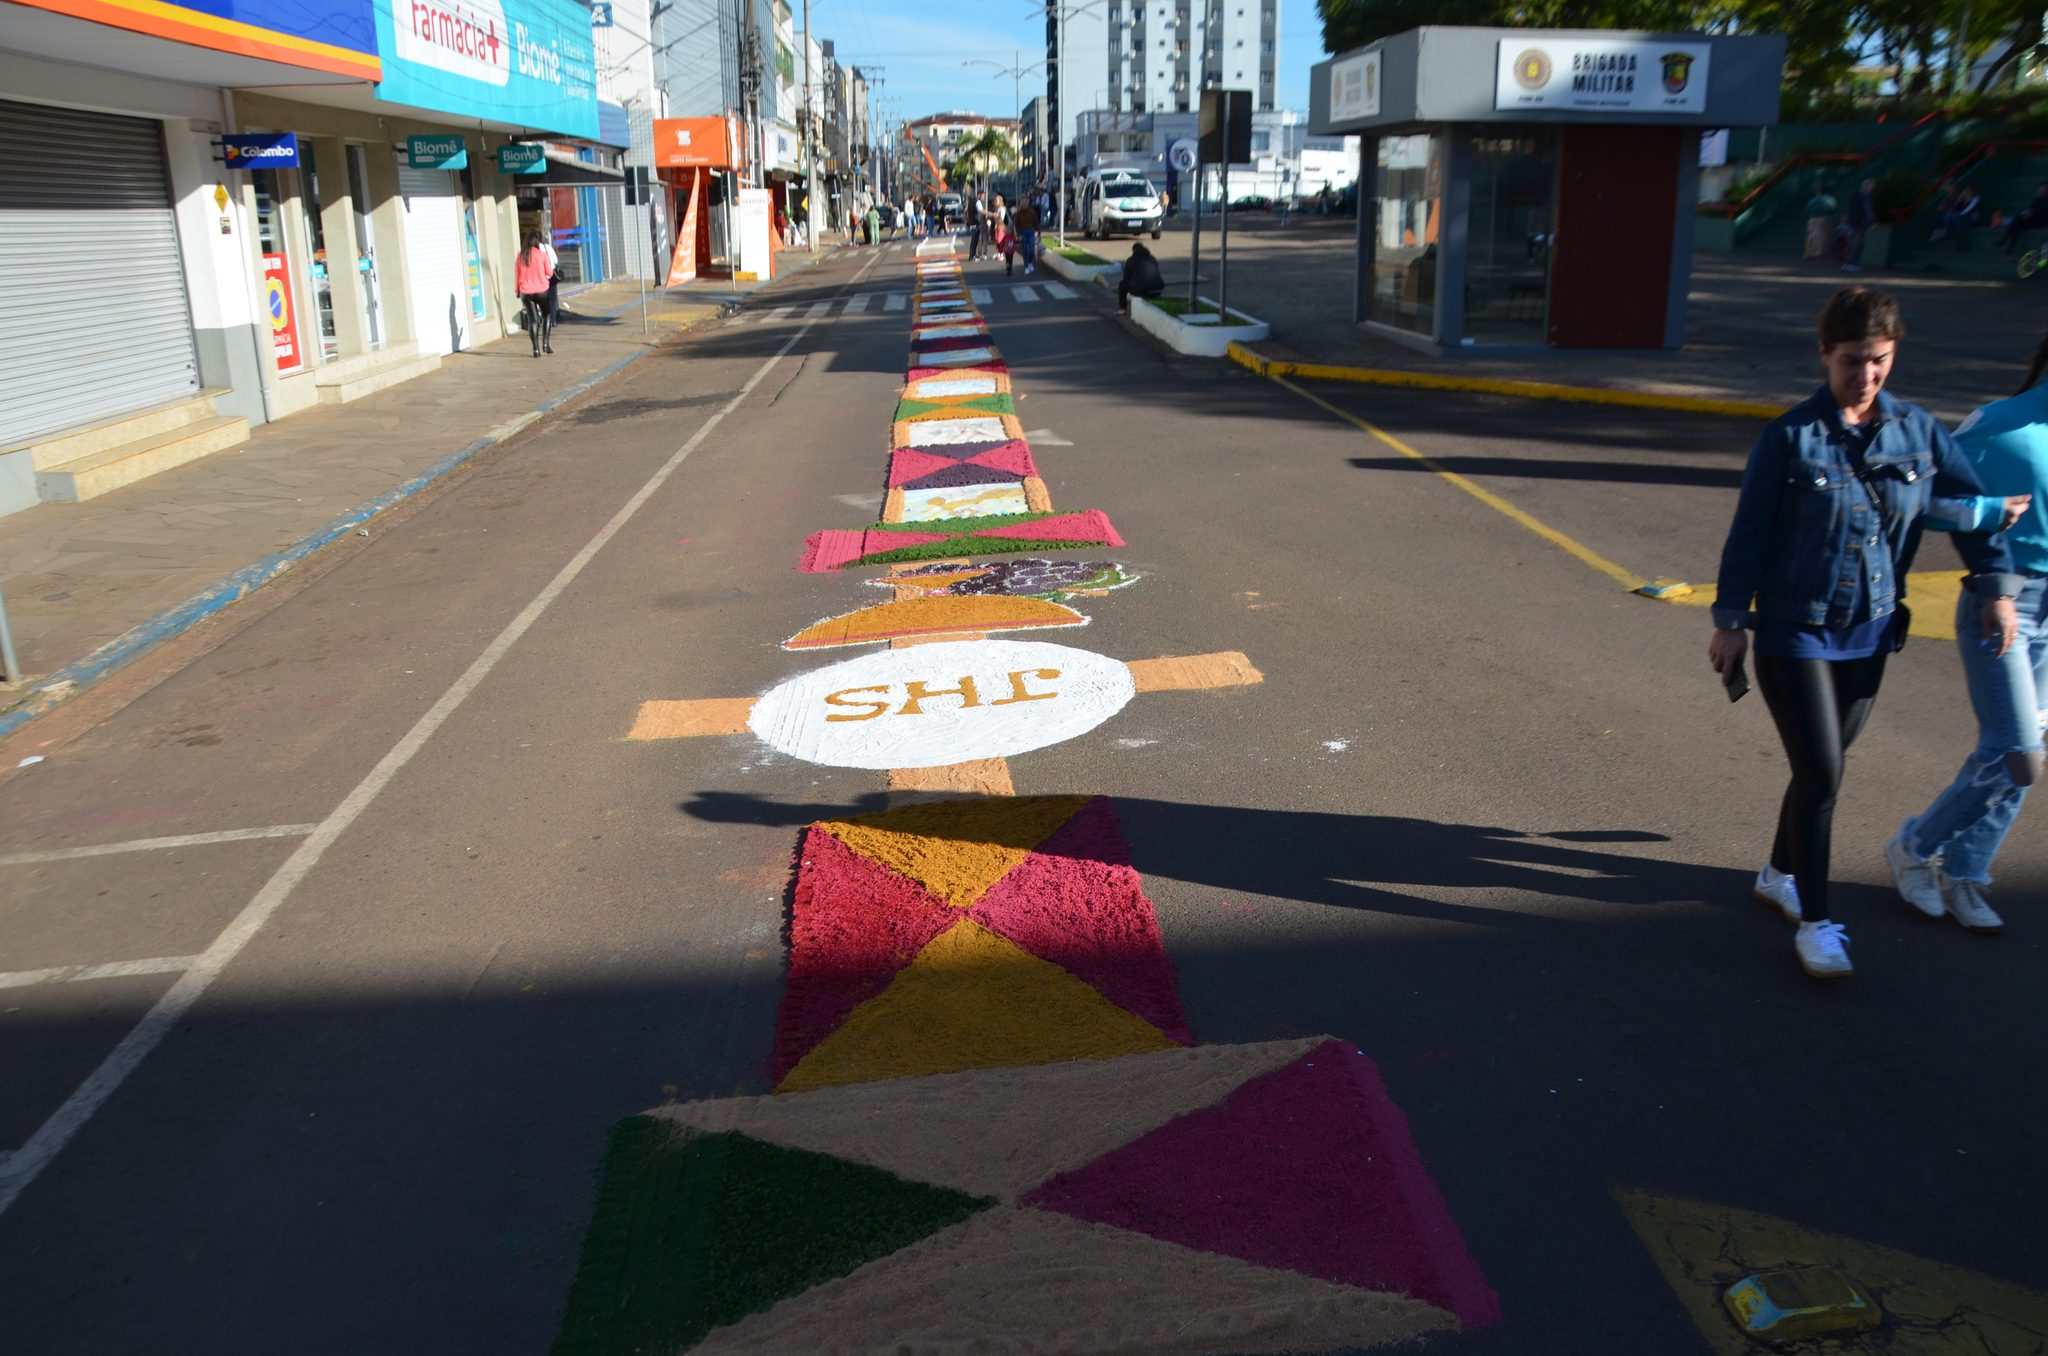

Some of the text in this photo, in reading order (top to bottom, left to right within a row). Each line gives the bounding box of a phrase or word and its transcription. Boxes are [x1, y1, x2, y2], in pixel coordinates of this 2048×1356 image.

[1573, 52, 1637, 72] BRIGADA
[1572, 74, 1635, 93] MILITAR
[240, 145, 294, 157] Colombo
